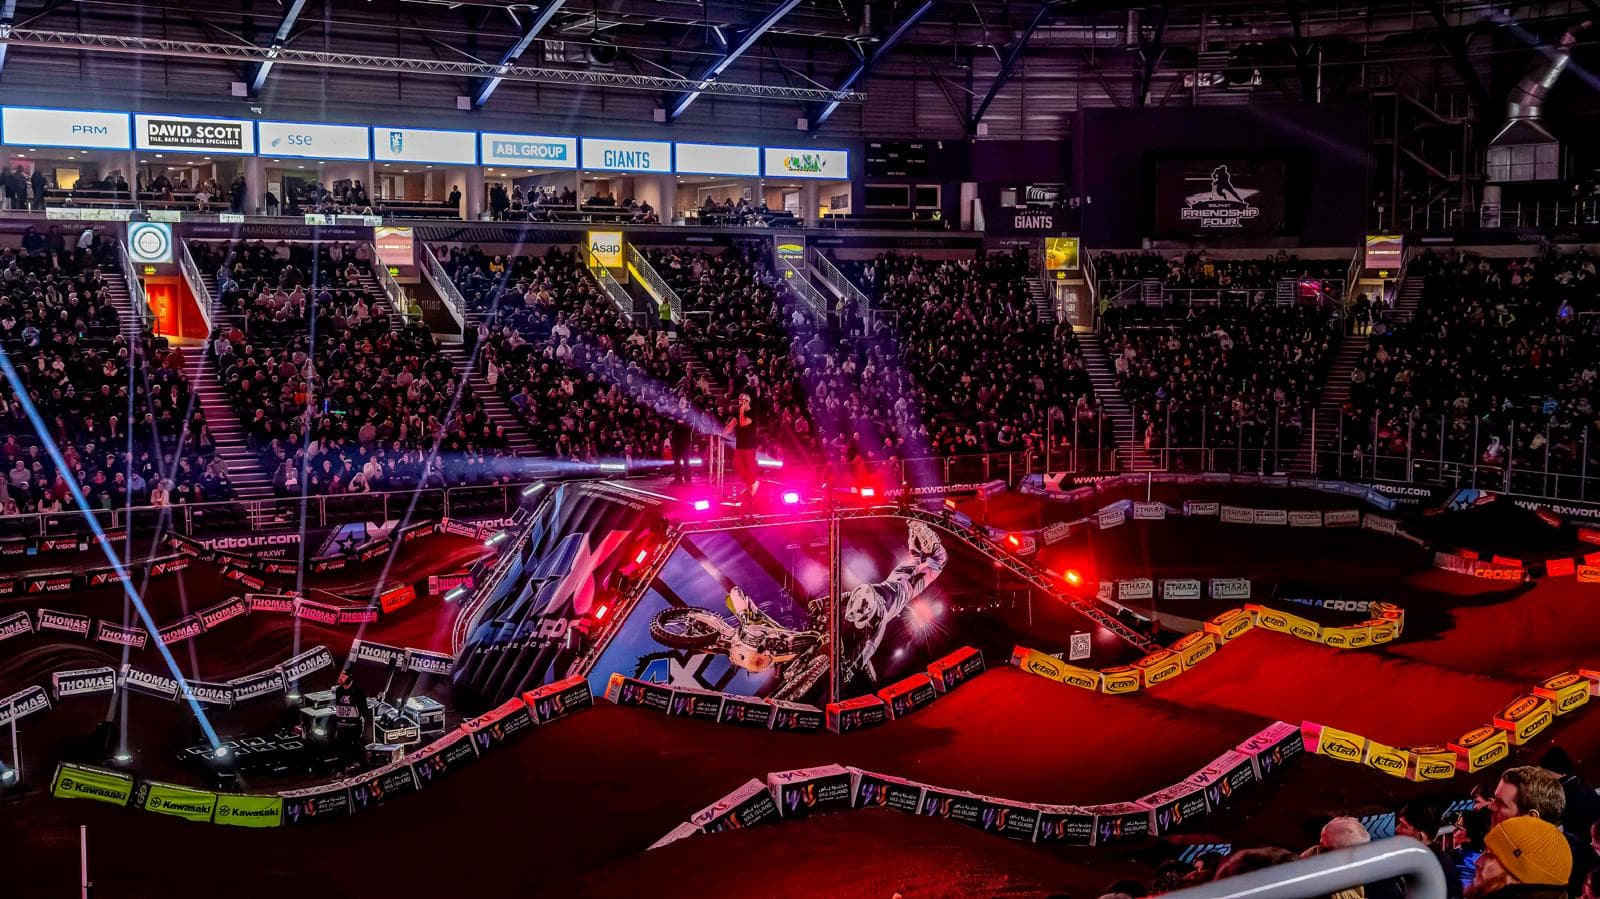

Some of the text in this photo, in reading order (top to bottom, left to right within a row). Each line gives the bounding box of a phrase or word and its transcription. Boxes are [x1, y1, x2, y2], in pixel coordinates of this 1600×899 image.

[72, 125, 108, 135] PRM
[149, 123, 241, 140] DAVID SCOTT
[288, 132, 313, 145] sse
[496, 144, 564, 158] ABL GROUP
[604, 149, 650, 169] GIANTS
[1183, 209, 1257, 217] FRIENDSHIP
[1015, 216, 1053, 229] GIANTS
[591, 242, 621, 256] Asap
[447, 521, 477, 533] OnGrade
[1120, 581, 1151, 591] ETHARA
[1166, 582, 1199, 591] ETHARA
[1214, 582, 1249, 591] ETHARA
[252, 598, 293, 609] THOMAS
[203, 602, 244, 624] THOMAS
[298, 606, 338, 622] THOMAS
[341, 611, 378, 621] THOMAS
[0, 618, 29, 635] OMAS
[43, 613, 88, 631] THOMAS
[101, 629, 145, 645] THOMAS
[360, 642, 405, 663] THOMAS
[287, 651, 330, 679] THOMAS
[410, 656, 453, 673] THOMAS
[59, 675, 113, 690] THOMAS
[129, 668, 178, 690] THOMAS
[234, 677, 283, 698] THOMAS
[74, 781, 127, 800] Kawasaki
[163, 799, 211, 814] Kawasaki
[232, 807, 279, 817] Kawasaki
